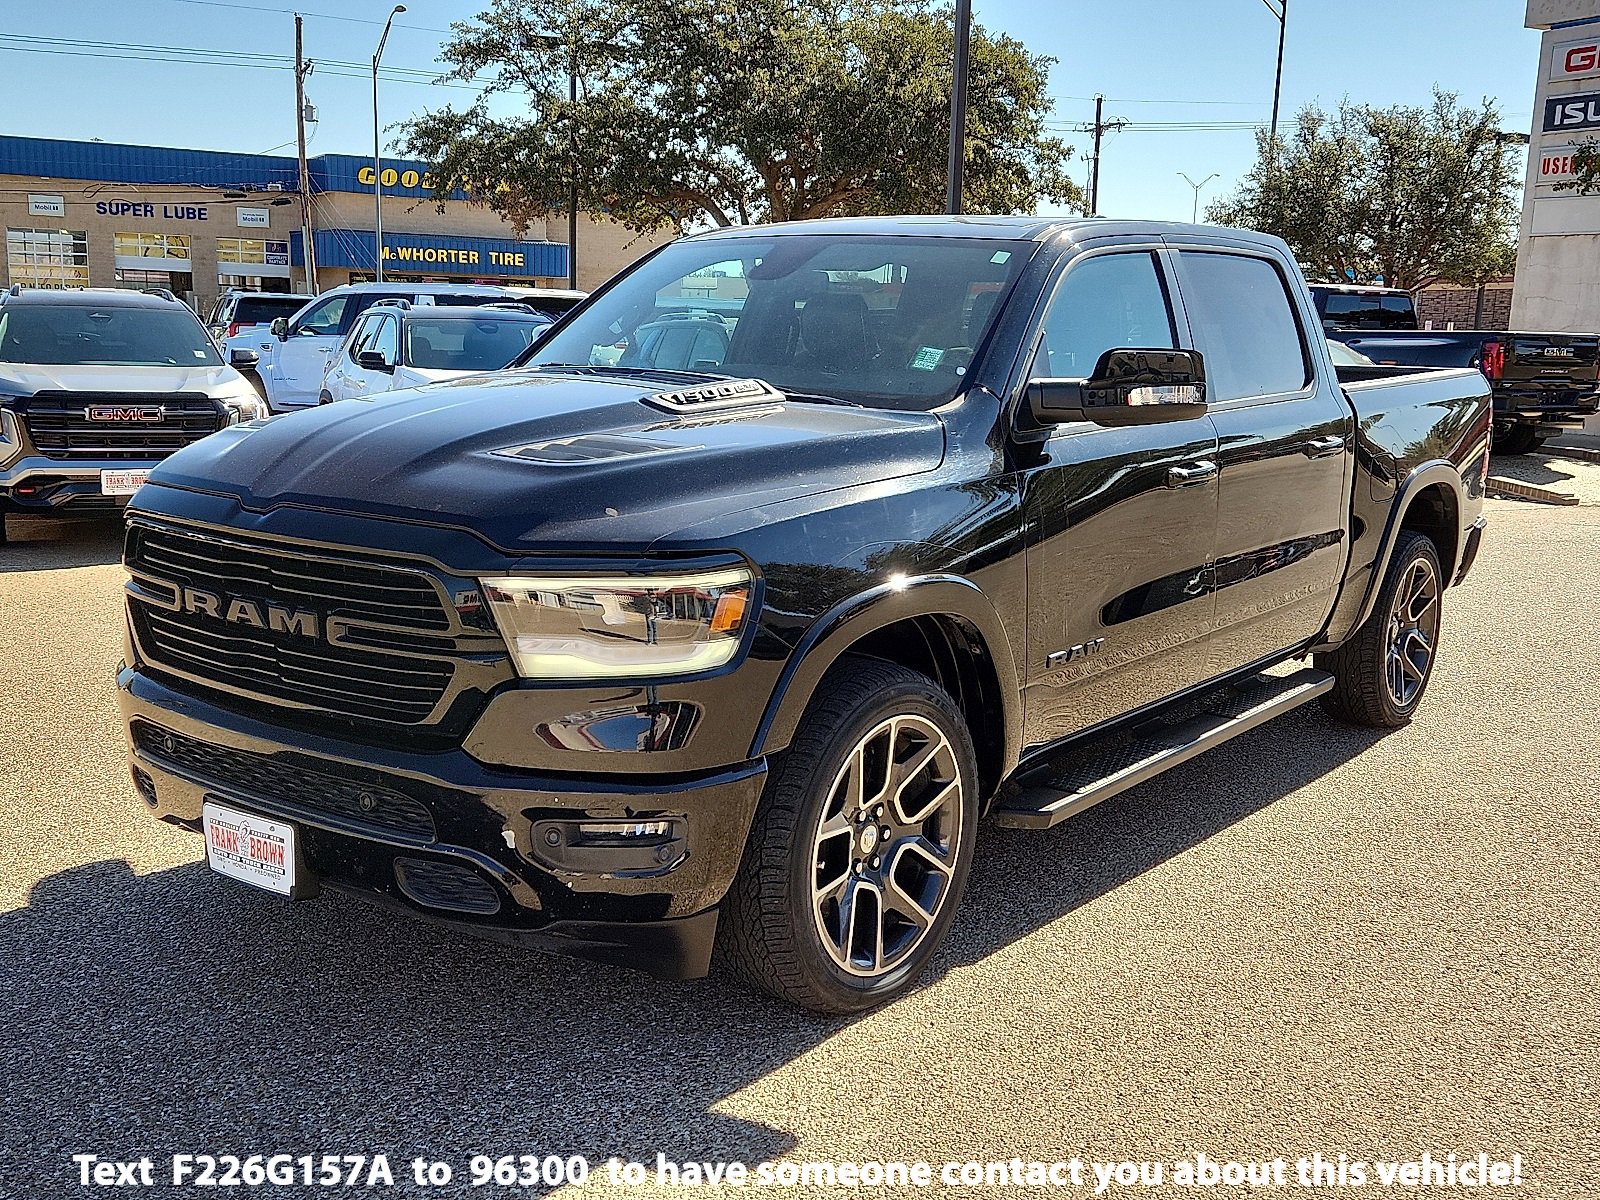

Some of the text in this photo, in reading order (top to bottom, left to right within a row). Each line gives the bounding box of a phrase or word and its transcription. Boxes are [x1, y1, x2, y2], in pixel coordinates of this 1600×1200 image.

[96, 201, 208, 221] SUPER LUBE
[489, 251, 525, 267] TIRE
[1543, 347, 1575, 357] GMC
[670, 385, 735, 405] 1500
[91, 407, 160, 421] GMC
[184, 587, 320, 638] RAM
[1045, 637, 1105, 668] RAM
[210, 823, 239, 854] FRANK
[250, 836, 285, 867] BROWN
